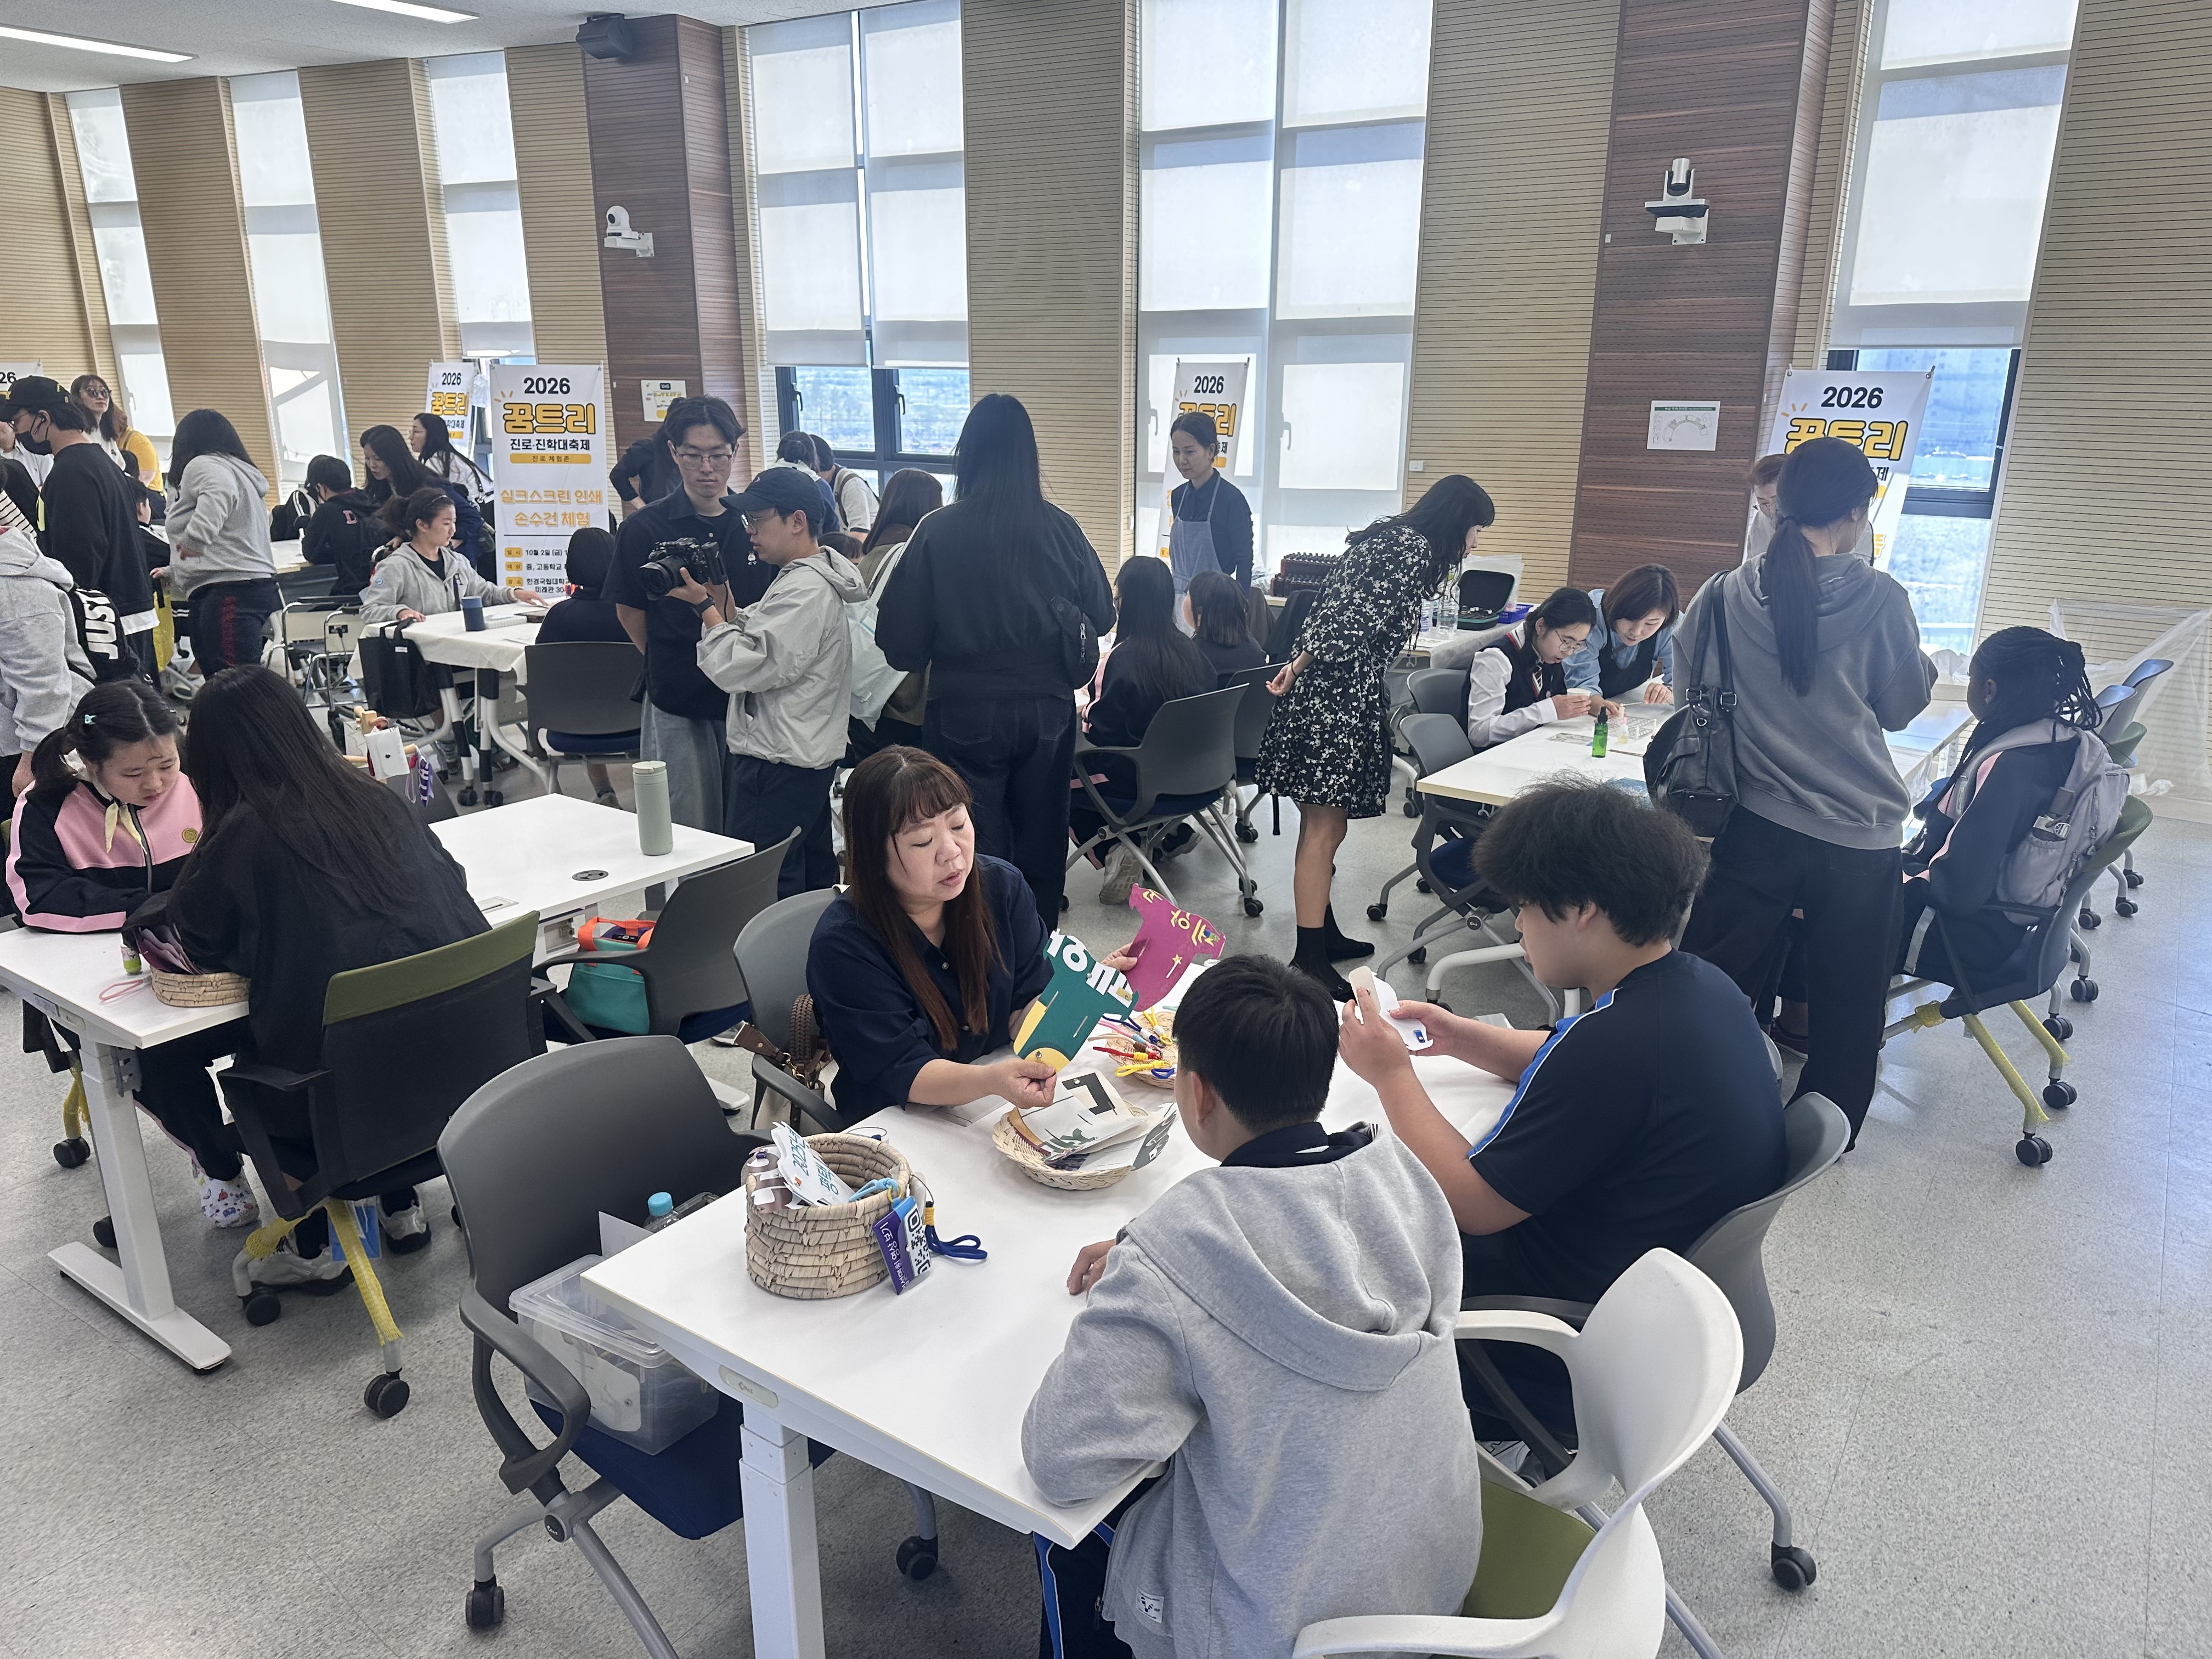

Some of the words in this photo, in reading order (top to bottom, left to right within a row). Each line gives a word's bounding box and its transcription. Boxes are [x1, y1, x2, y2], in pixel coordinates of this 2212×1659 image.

[442, 373, 461, 385] 2026
[523, 377, 571, 394] 2026
[1194, 376, 1224, 394] 2026
[431, 392, 470, 416] 꿈트리
[1821, 386, 1884, 409] 2026
[503, 403, 596, 435] 꿈트리
[500, 489, 571, 504] 실크스크린
[574, 489, 602, 504] 인쇄
[342, 510, 358, 524] D
[514, 512, 558, 527] 손수건
[561, 512, 591, 527] 체험
[879, 1221, 894, 1243] 보기
